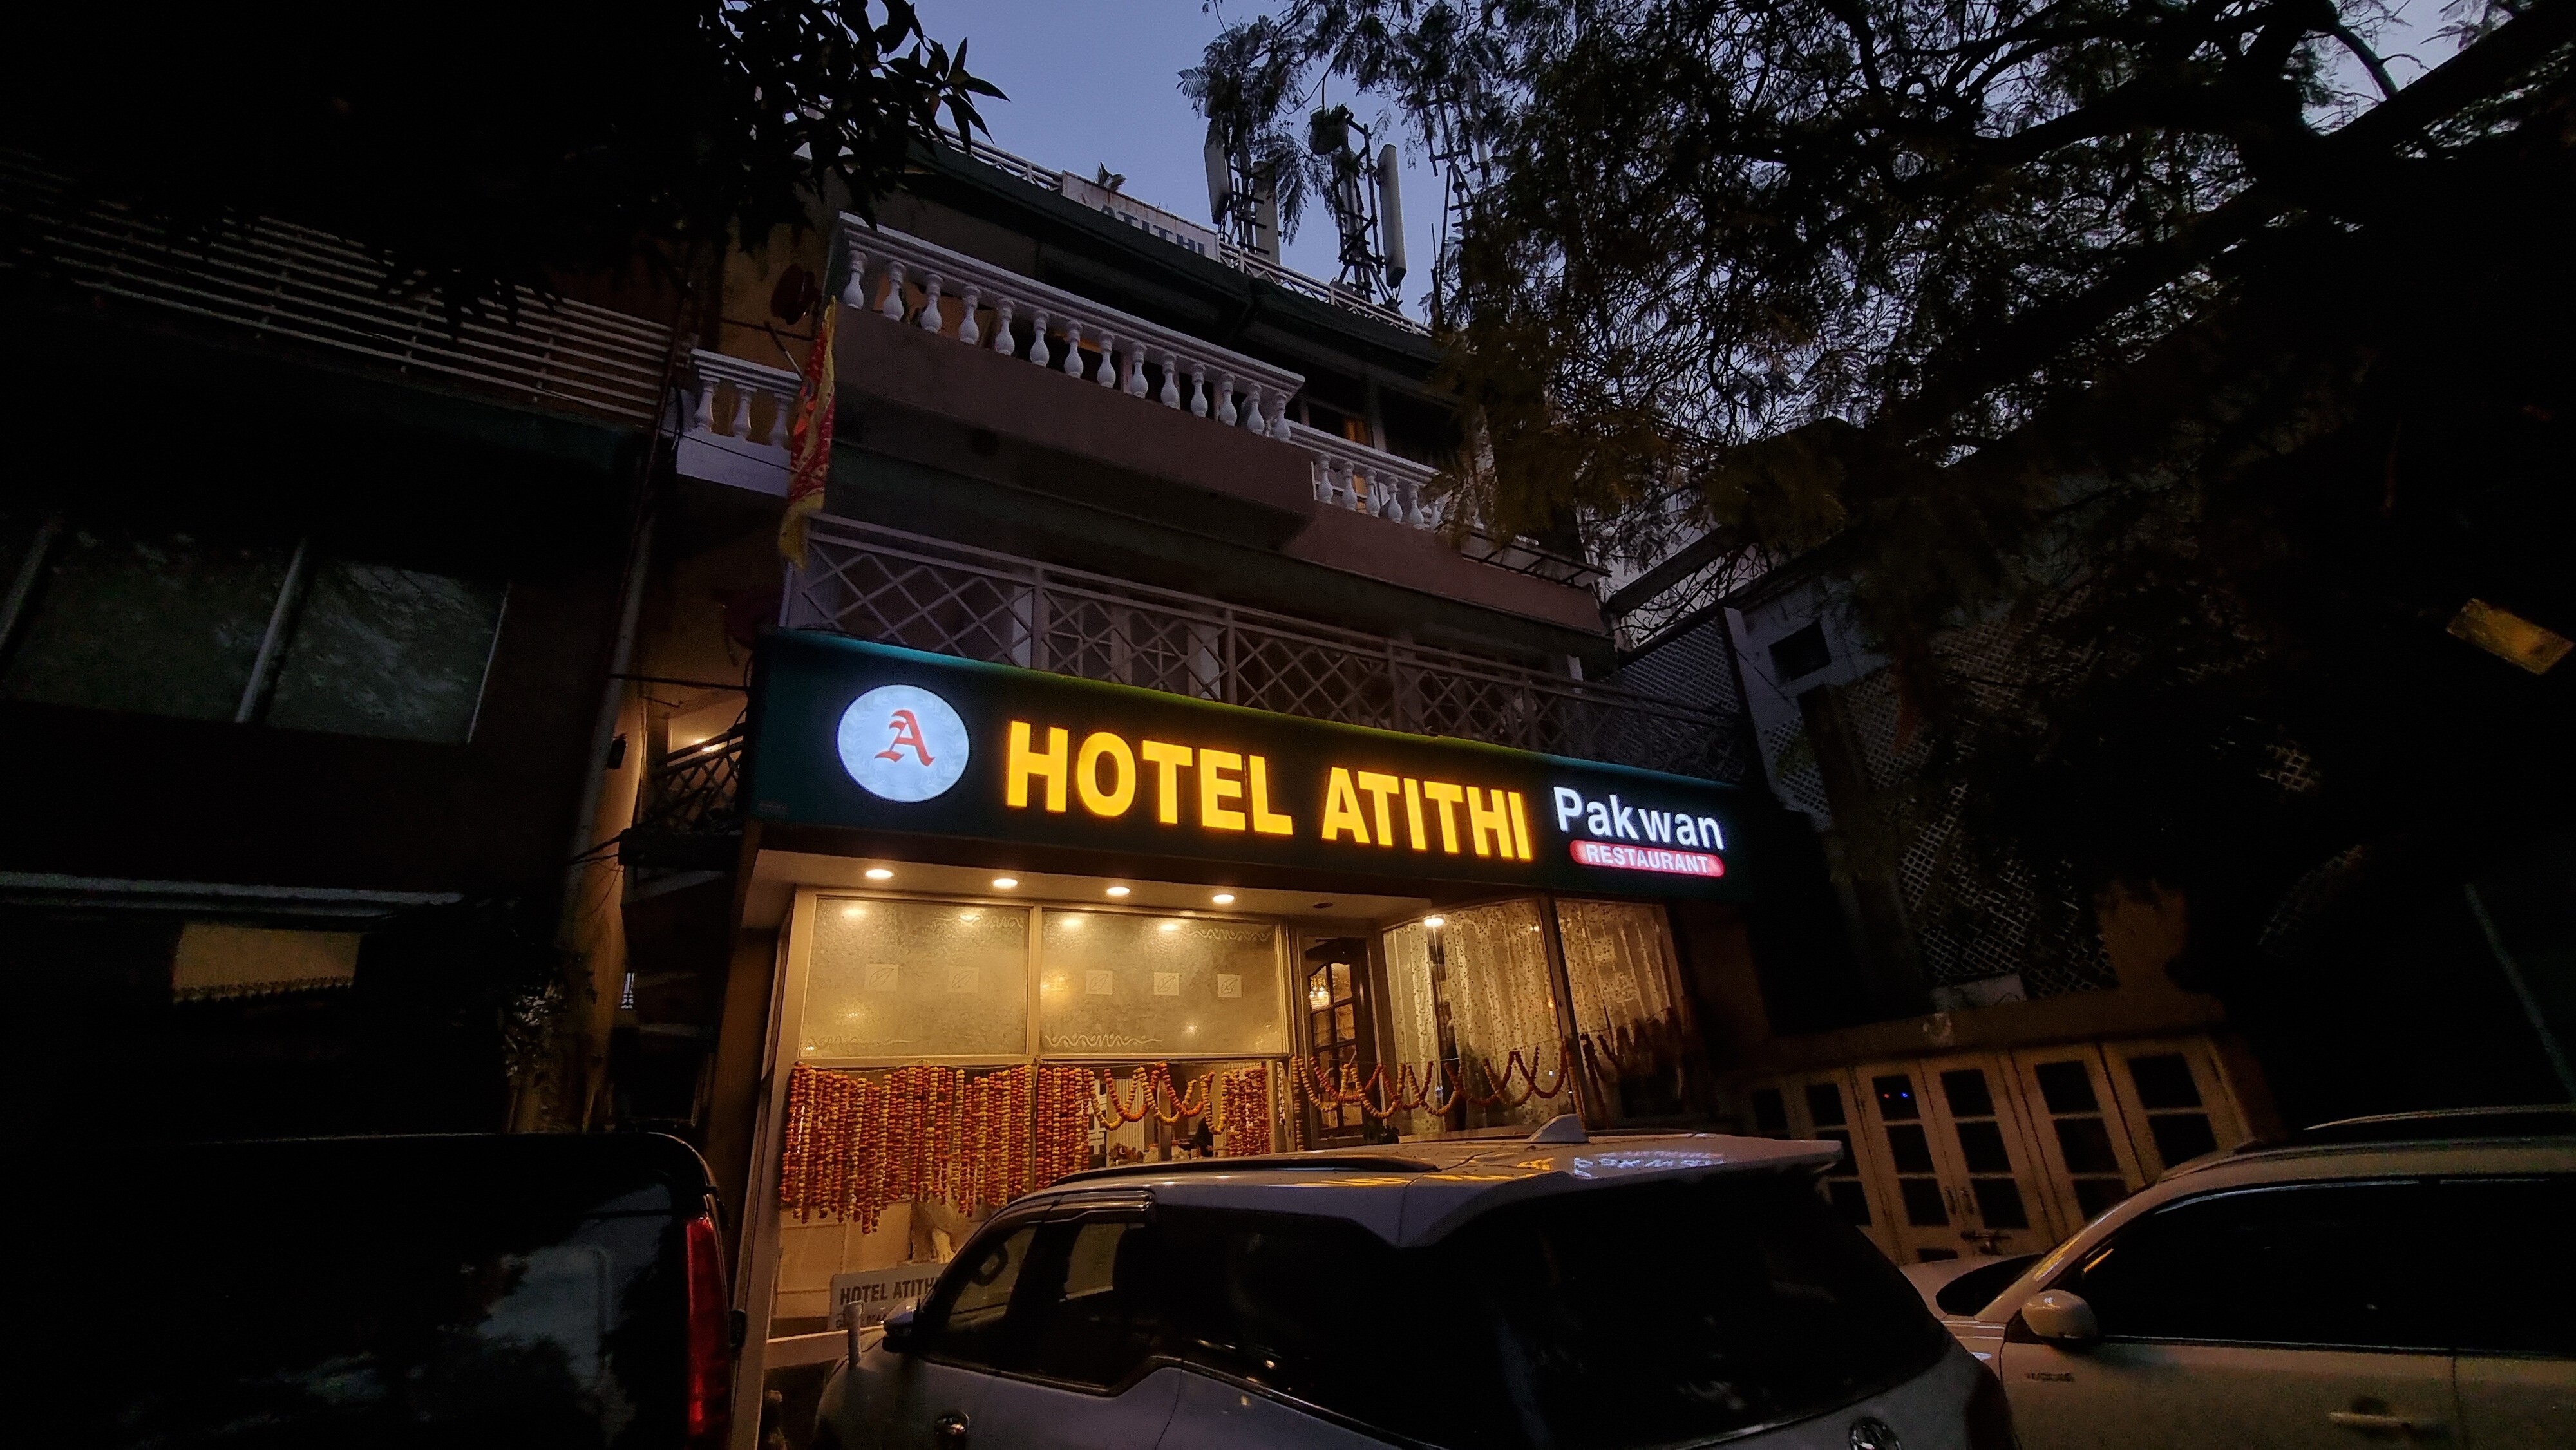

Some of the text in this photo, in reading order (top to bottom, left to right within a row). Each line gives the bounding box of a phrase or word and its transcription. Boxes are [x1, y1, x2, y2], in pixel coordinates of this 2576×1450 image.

[874, 709, 936, 767] A
[1007, 720, 1532, 860] HOTEL ATITHI
[1553, 786, 1725, 851] Pakwan
[1585, 843, 1709, 873] RESTAURANT
[840, 1277, 936, 1305] HOTEL ATITH
